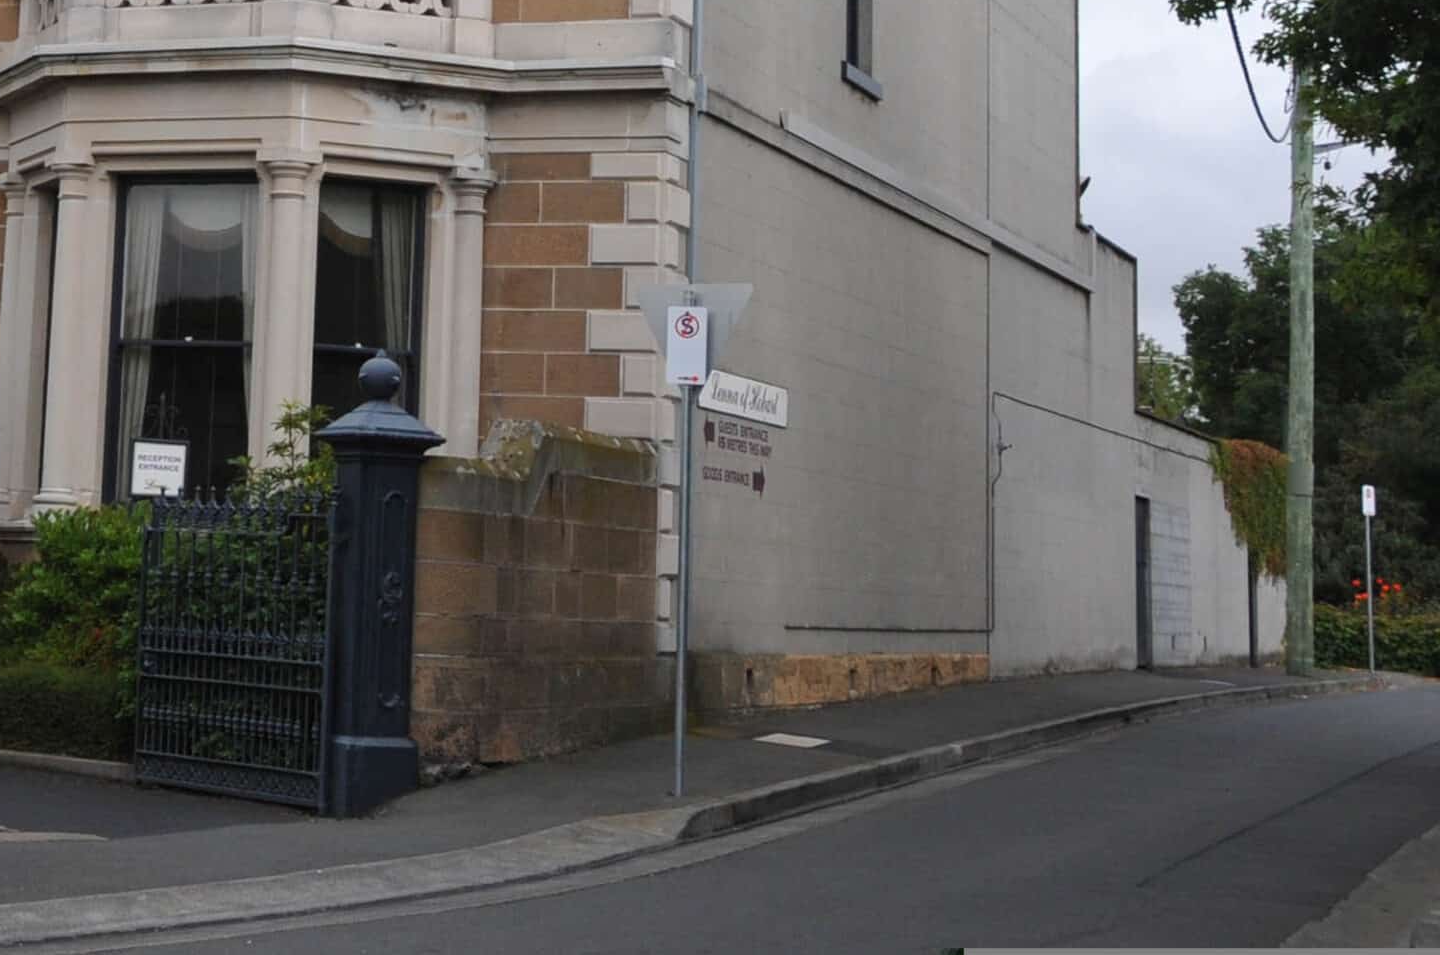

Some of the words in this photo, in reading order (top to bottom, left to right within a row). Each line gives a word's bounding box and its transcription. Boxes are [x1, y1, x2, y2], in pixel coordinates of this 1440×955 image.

[740, 425, 768, 443] ENTRANCE
[138, 454, 181, 462] RECEPTION
[139, 463, 179, 472] ENTRANCE
[724, 470, 750, 486] ENTRANCE
